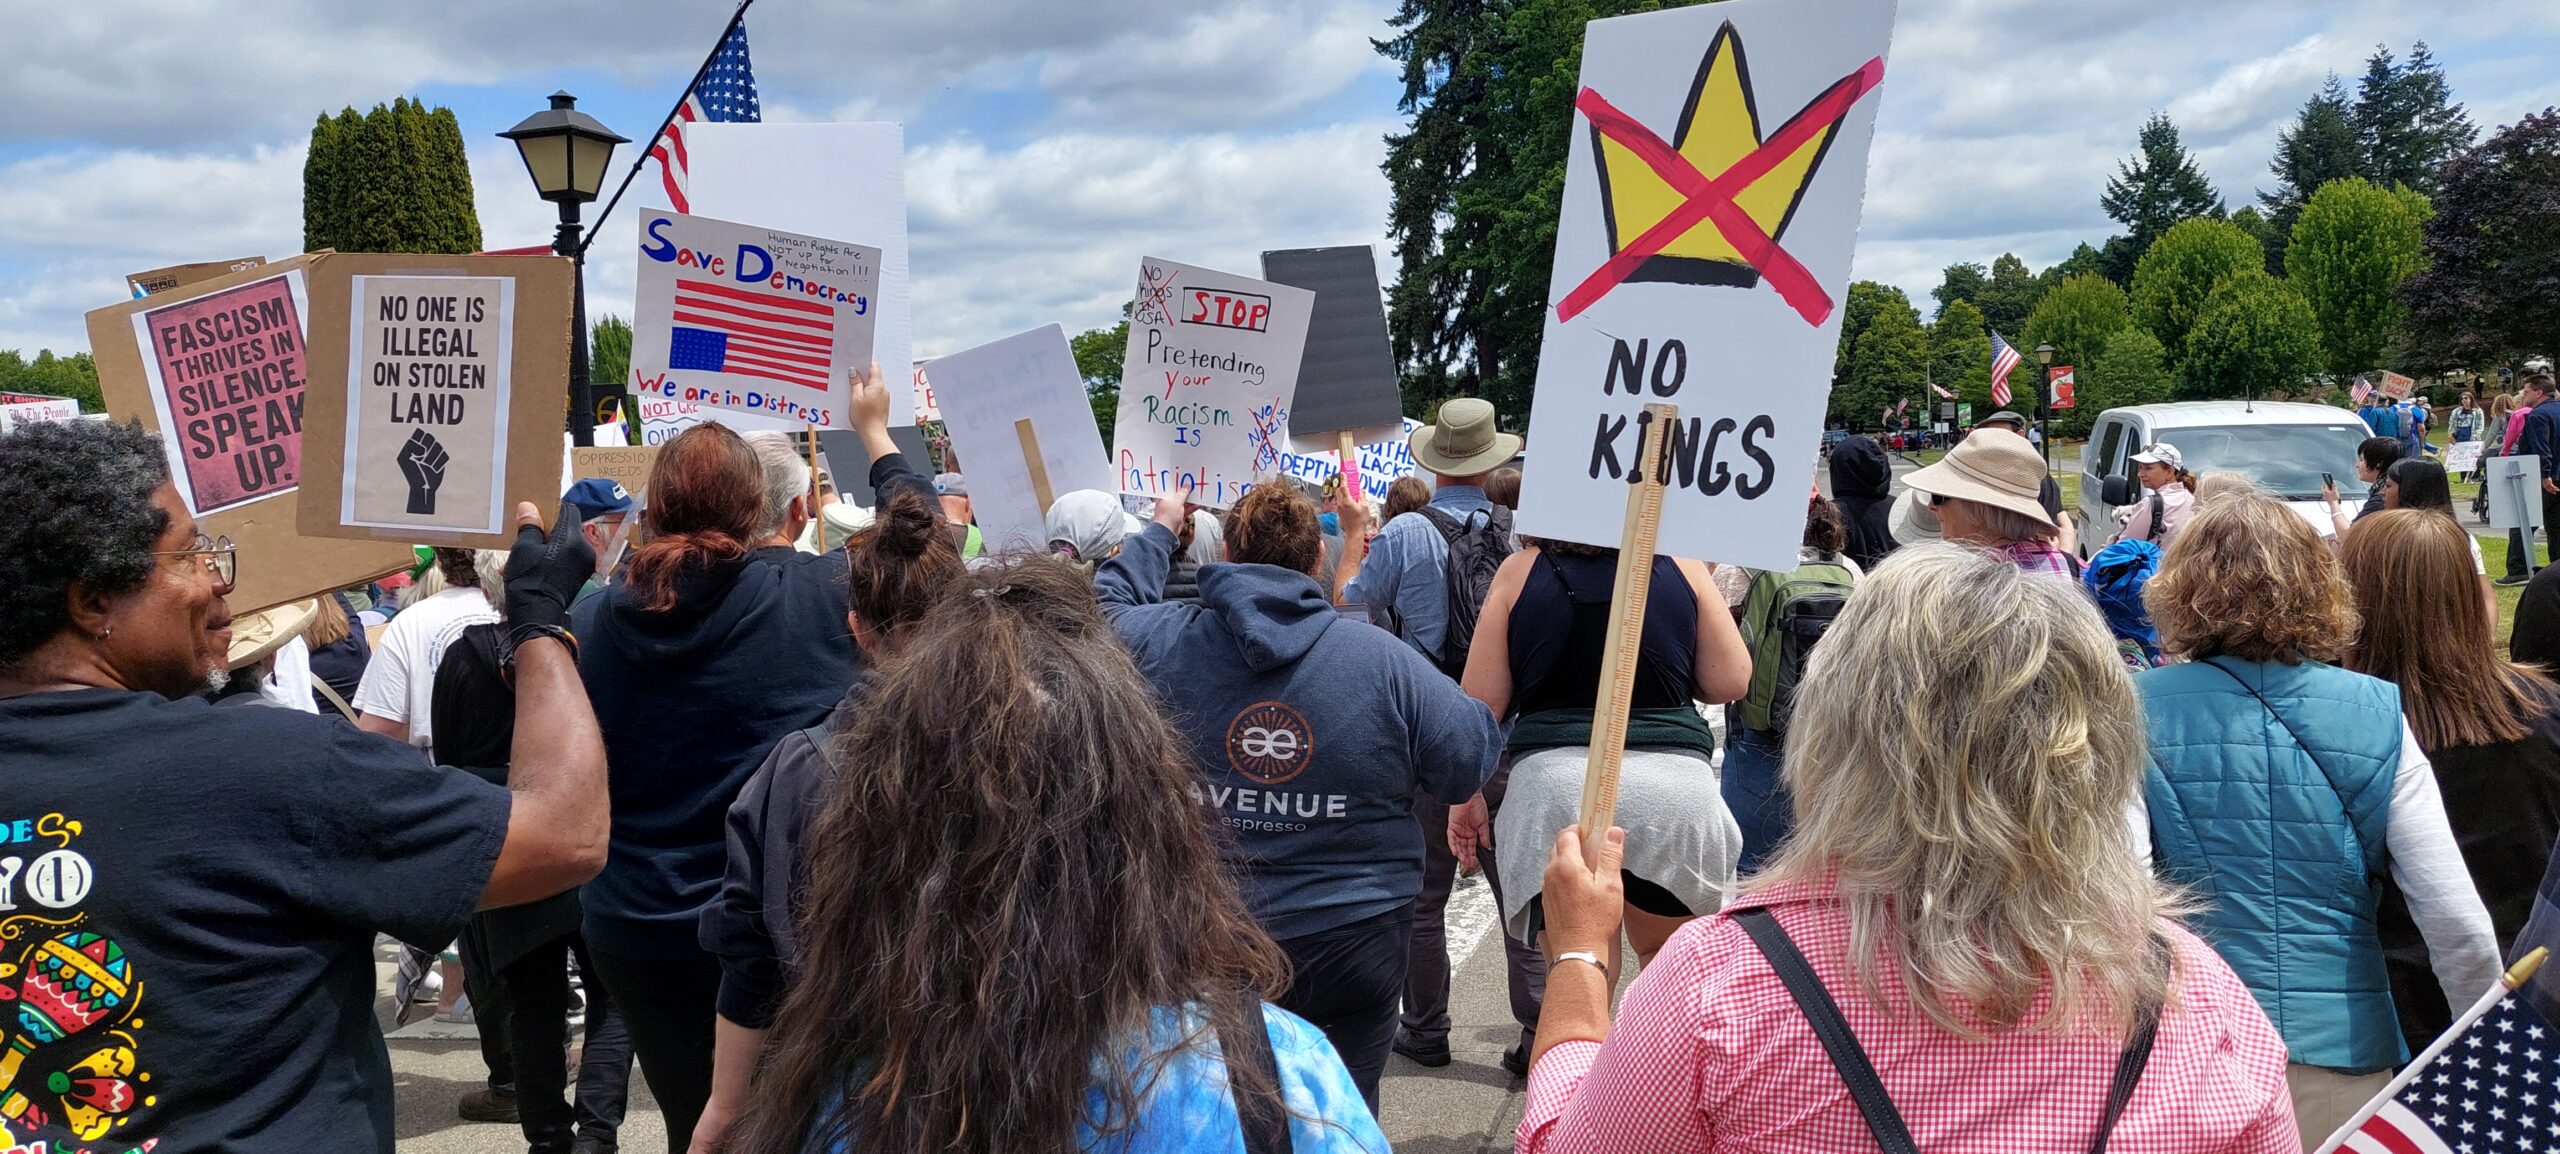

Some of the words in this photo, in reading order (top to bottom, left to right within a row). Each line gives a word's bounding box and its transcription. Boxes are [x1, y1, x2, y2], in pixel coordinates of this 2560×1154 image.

[767, 232, 807, 248] Human
[810, 240, 839, 256] Rights
[843, 247, 862, 260] Are
[767, 244, 793, 255] NOT
[640, 218, 726, 276] Save
[735, 243, 868, 316] Democracy
[785, 261, 849, 276] Negotiation
[1142, 264, 1162, 281] NO
[380, 295, 408, 321] NO
[416, 296, 457, 322] ONE
[465, 297, 485, 323] IS
[1134, 311, 1165, 325] USA
[1192, 291, 1268, 330] STOP
[161, 297, 288, 357] FASCISM
[382, 327, 479, 357] ILLEGAL
[170, 338, 266, 382] THRIVES
[270, 330, 295, 356] IN
[1147, 328, 1265, 386] Pretending
[1603, 338, 1688, 398] NO
[179, 358, 306, 416] SILENCE.
[373, 361, 400, 387] ON
[408, 362, 486, 389] STOLEN
[2388, 375, 2411, 388] FIGHT
[390, 392, 465, 425] LAND
[635, 368, 676, 397] We
[685, 386, 720, 405] are
[725, 390, 741, 405] in
[746, 391, 831, 426] Distress
[643, 402, 672, 417] NOT
[1143, 395, 1234, 427] Racism
[25, 407, 41, 421] The
[188, 391, 305, 460] SPEAK
[234, 443, 292, 492] UP.
[1588, 411, 1776, 500] KINGS
[599, 466, 643, 479] BREEDS
[1187, 781, 1348, 818] AVENUE
[1221, 815, 1307, 832] espresso
